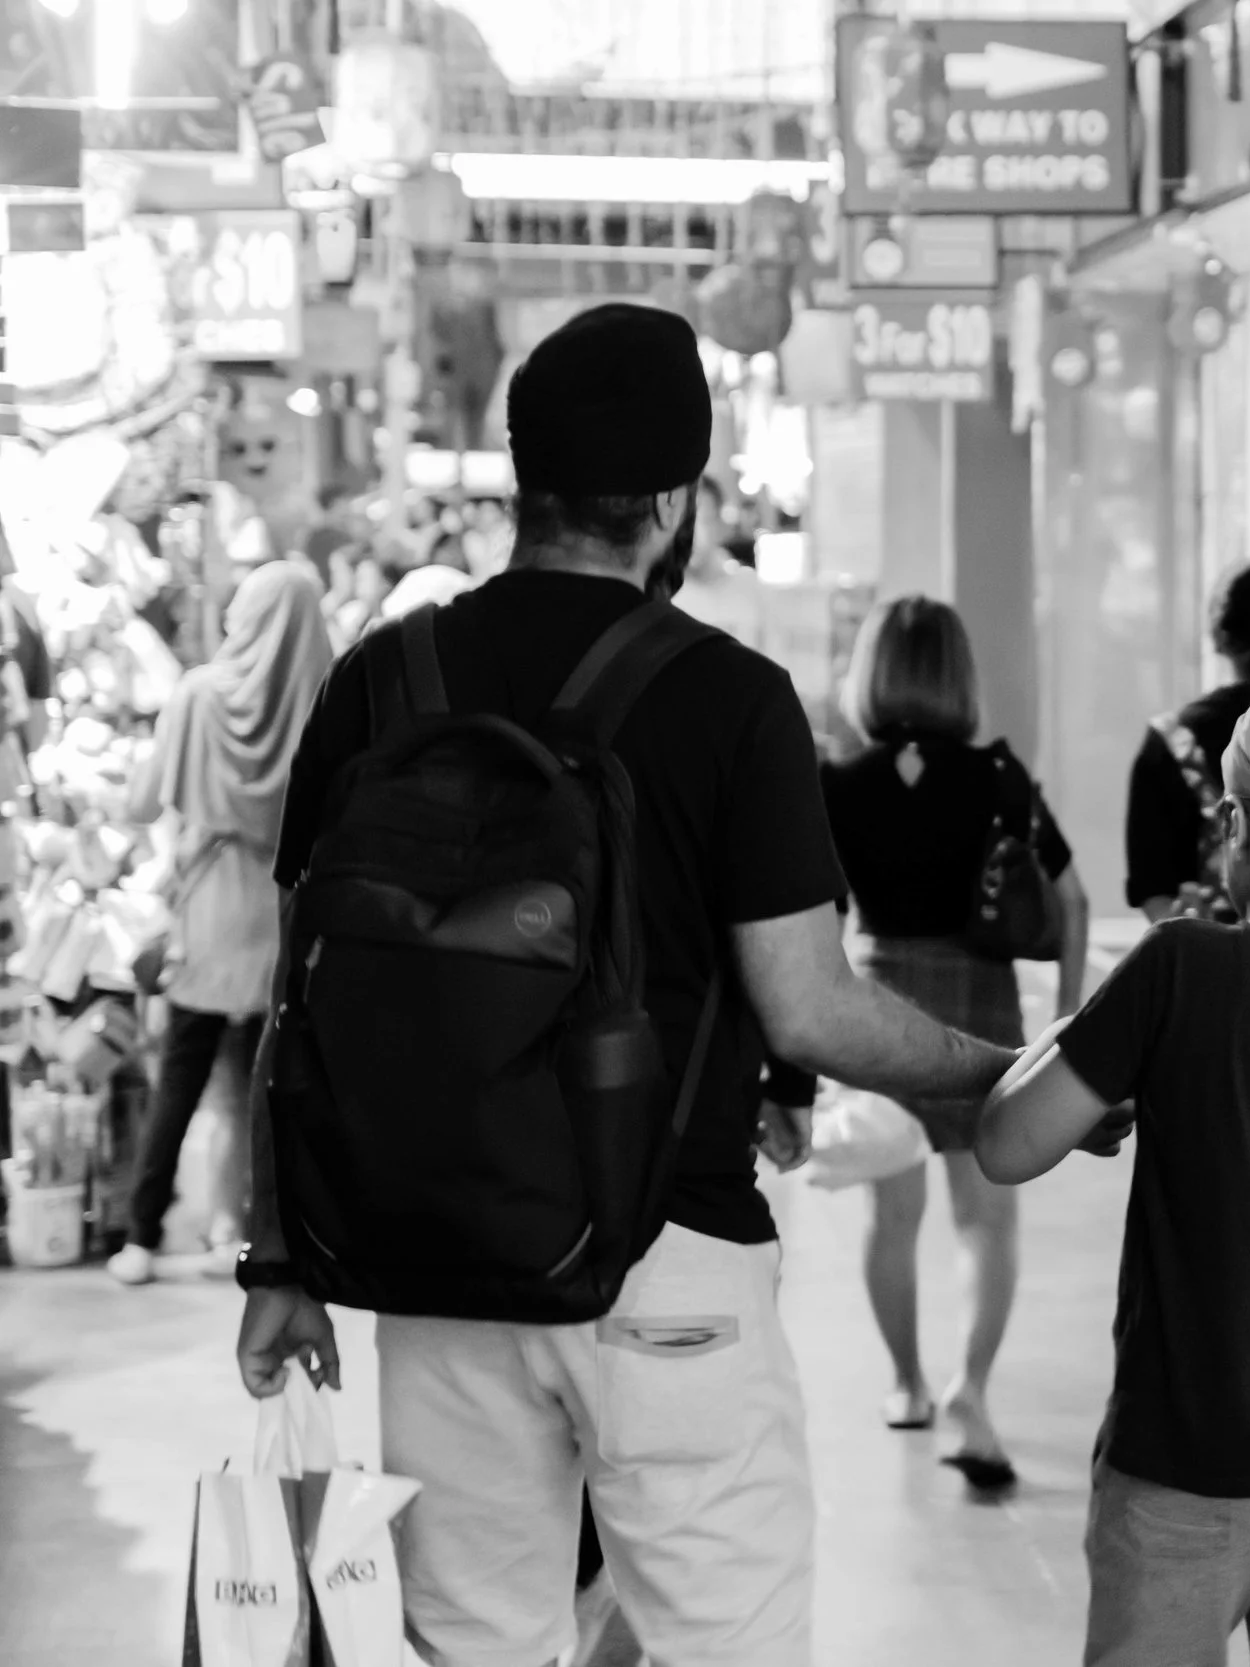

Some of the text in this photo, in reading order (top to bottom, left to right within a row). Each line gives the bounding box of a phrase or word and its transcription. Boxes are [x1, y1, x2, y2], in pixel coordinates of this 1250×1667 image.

[969, 109, 1053, 146] WAY
[1058, 109, 1110, 146] TO
[982, 153, 1111, 192] SHOPS
[212, 228, 296, 316] $10
[853, 303, 880, 367] 3
[927, 302, 991, 369] $10
